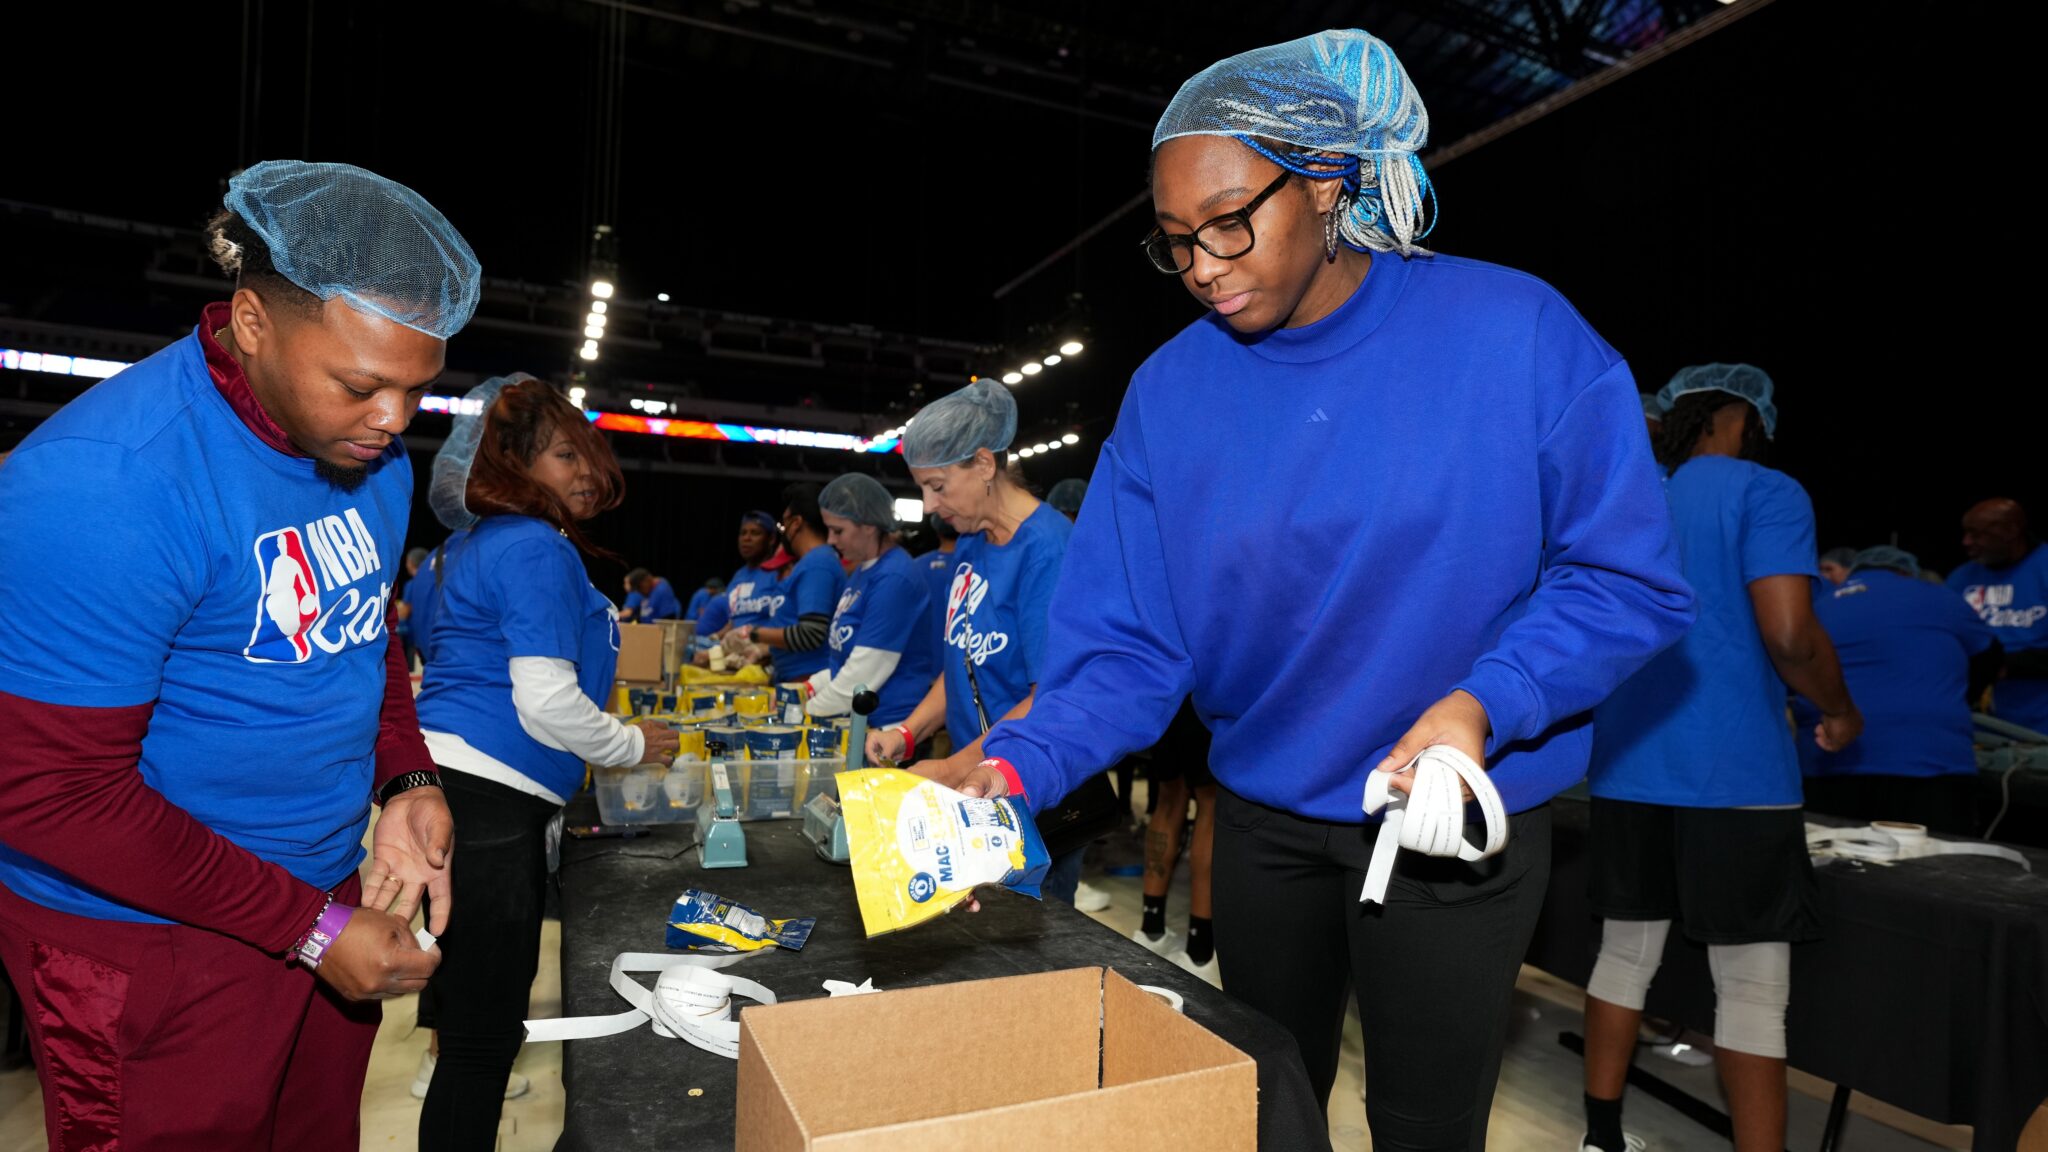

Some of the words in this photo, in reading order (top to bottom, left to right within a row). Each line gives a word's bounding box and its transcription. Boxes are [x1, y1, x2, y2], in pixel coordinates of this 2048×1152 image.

[305, 507, 381, 592] NBA
[310, 582, 393, 654] Car
[936, 845, 953, 882] MAC
